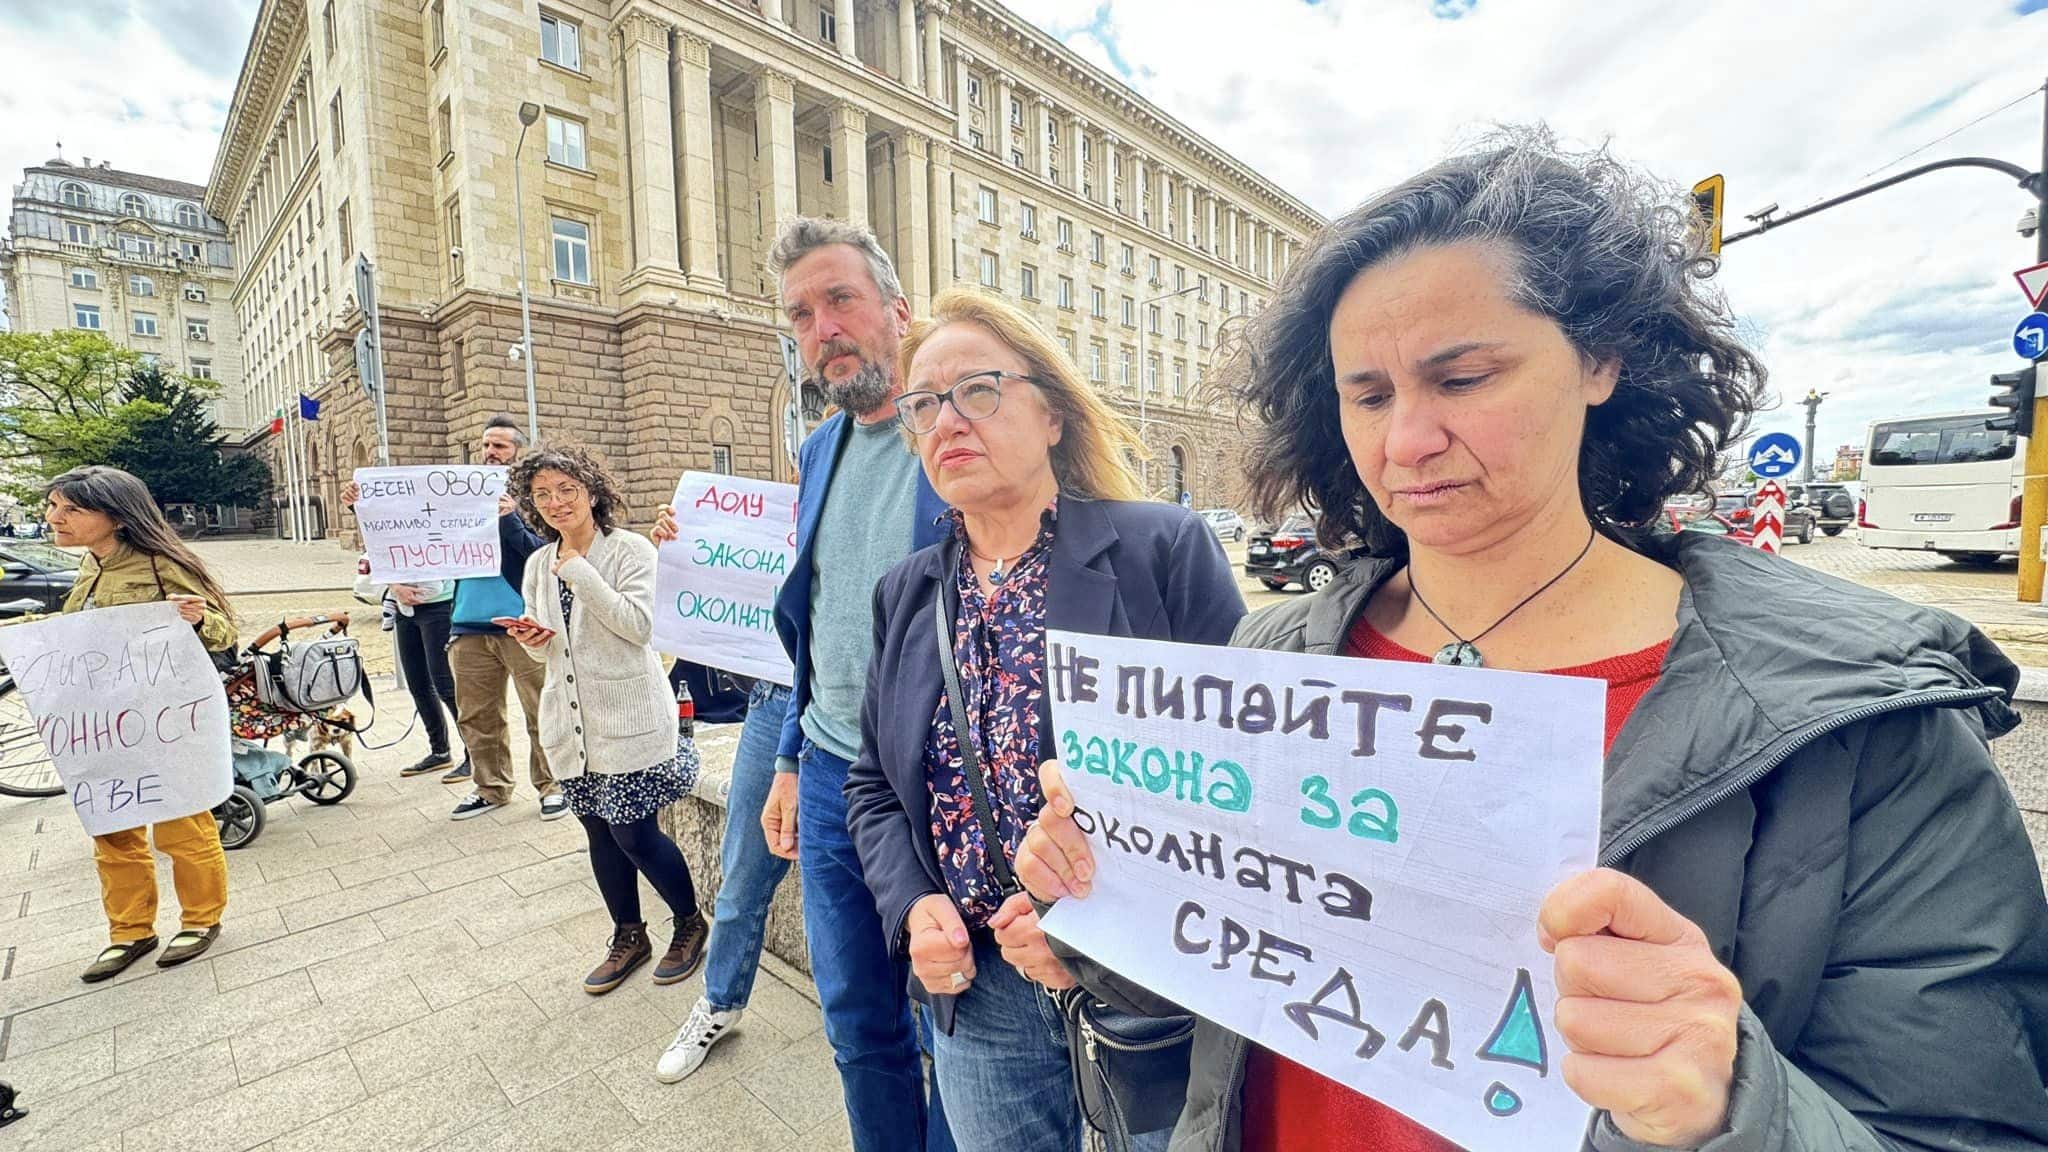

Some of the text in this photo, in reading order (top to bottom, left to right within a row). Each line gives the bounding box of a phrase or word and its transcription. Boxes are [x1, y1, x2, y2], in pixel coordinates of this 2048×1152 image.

[427, 470, 498, 496] ОВОС
[696, 486, 764, 517] ДОЛУ
[389, 543, 496, 569] ПУСТИНЯ
[692, 539, 785, 575] ЗАКОНА
[677, 591, 775, 633] ОКОЛНАТ
[1049, 643, 1099, 702] НЕ
